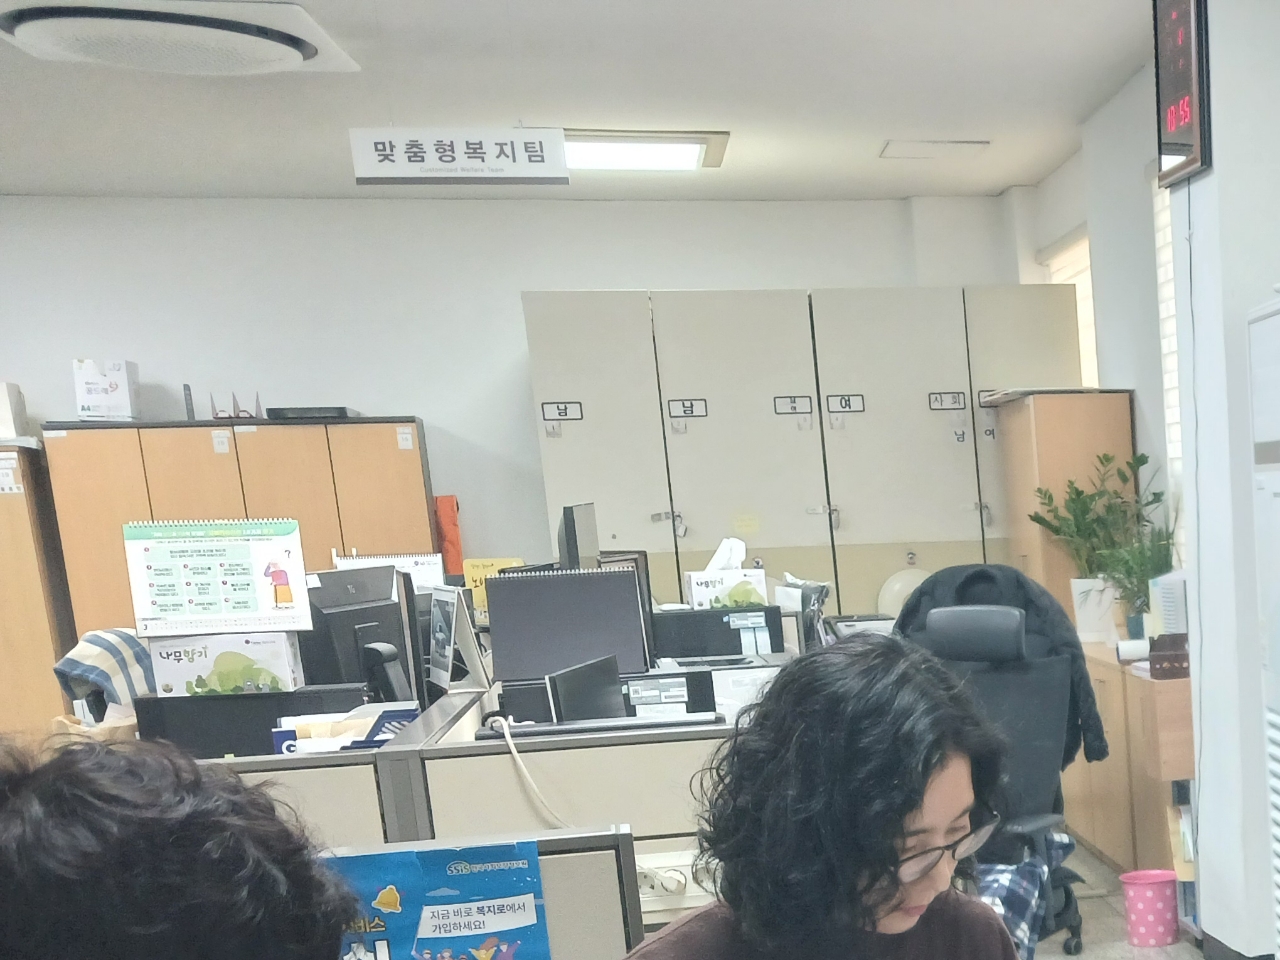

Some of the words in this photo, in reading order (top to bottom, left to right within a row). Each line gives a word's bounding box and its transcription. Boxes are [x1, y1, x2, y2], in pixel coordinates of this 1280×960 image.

[374, 139, 545, 164] 맞춤형복지팀
[80, 404, 91, 412] A4
[557, 404, 568, 417] 남
[682, 401, 694, 415] 남
[159, 645, 208, 663] 나무향기
[430, 909, 450, 920] 지금
[453, 907, 473, 919] 바로
[476, 902, 526, 916] 복지로에서
[432, 921, 486, 934] 가입하세요!
